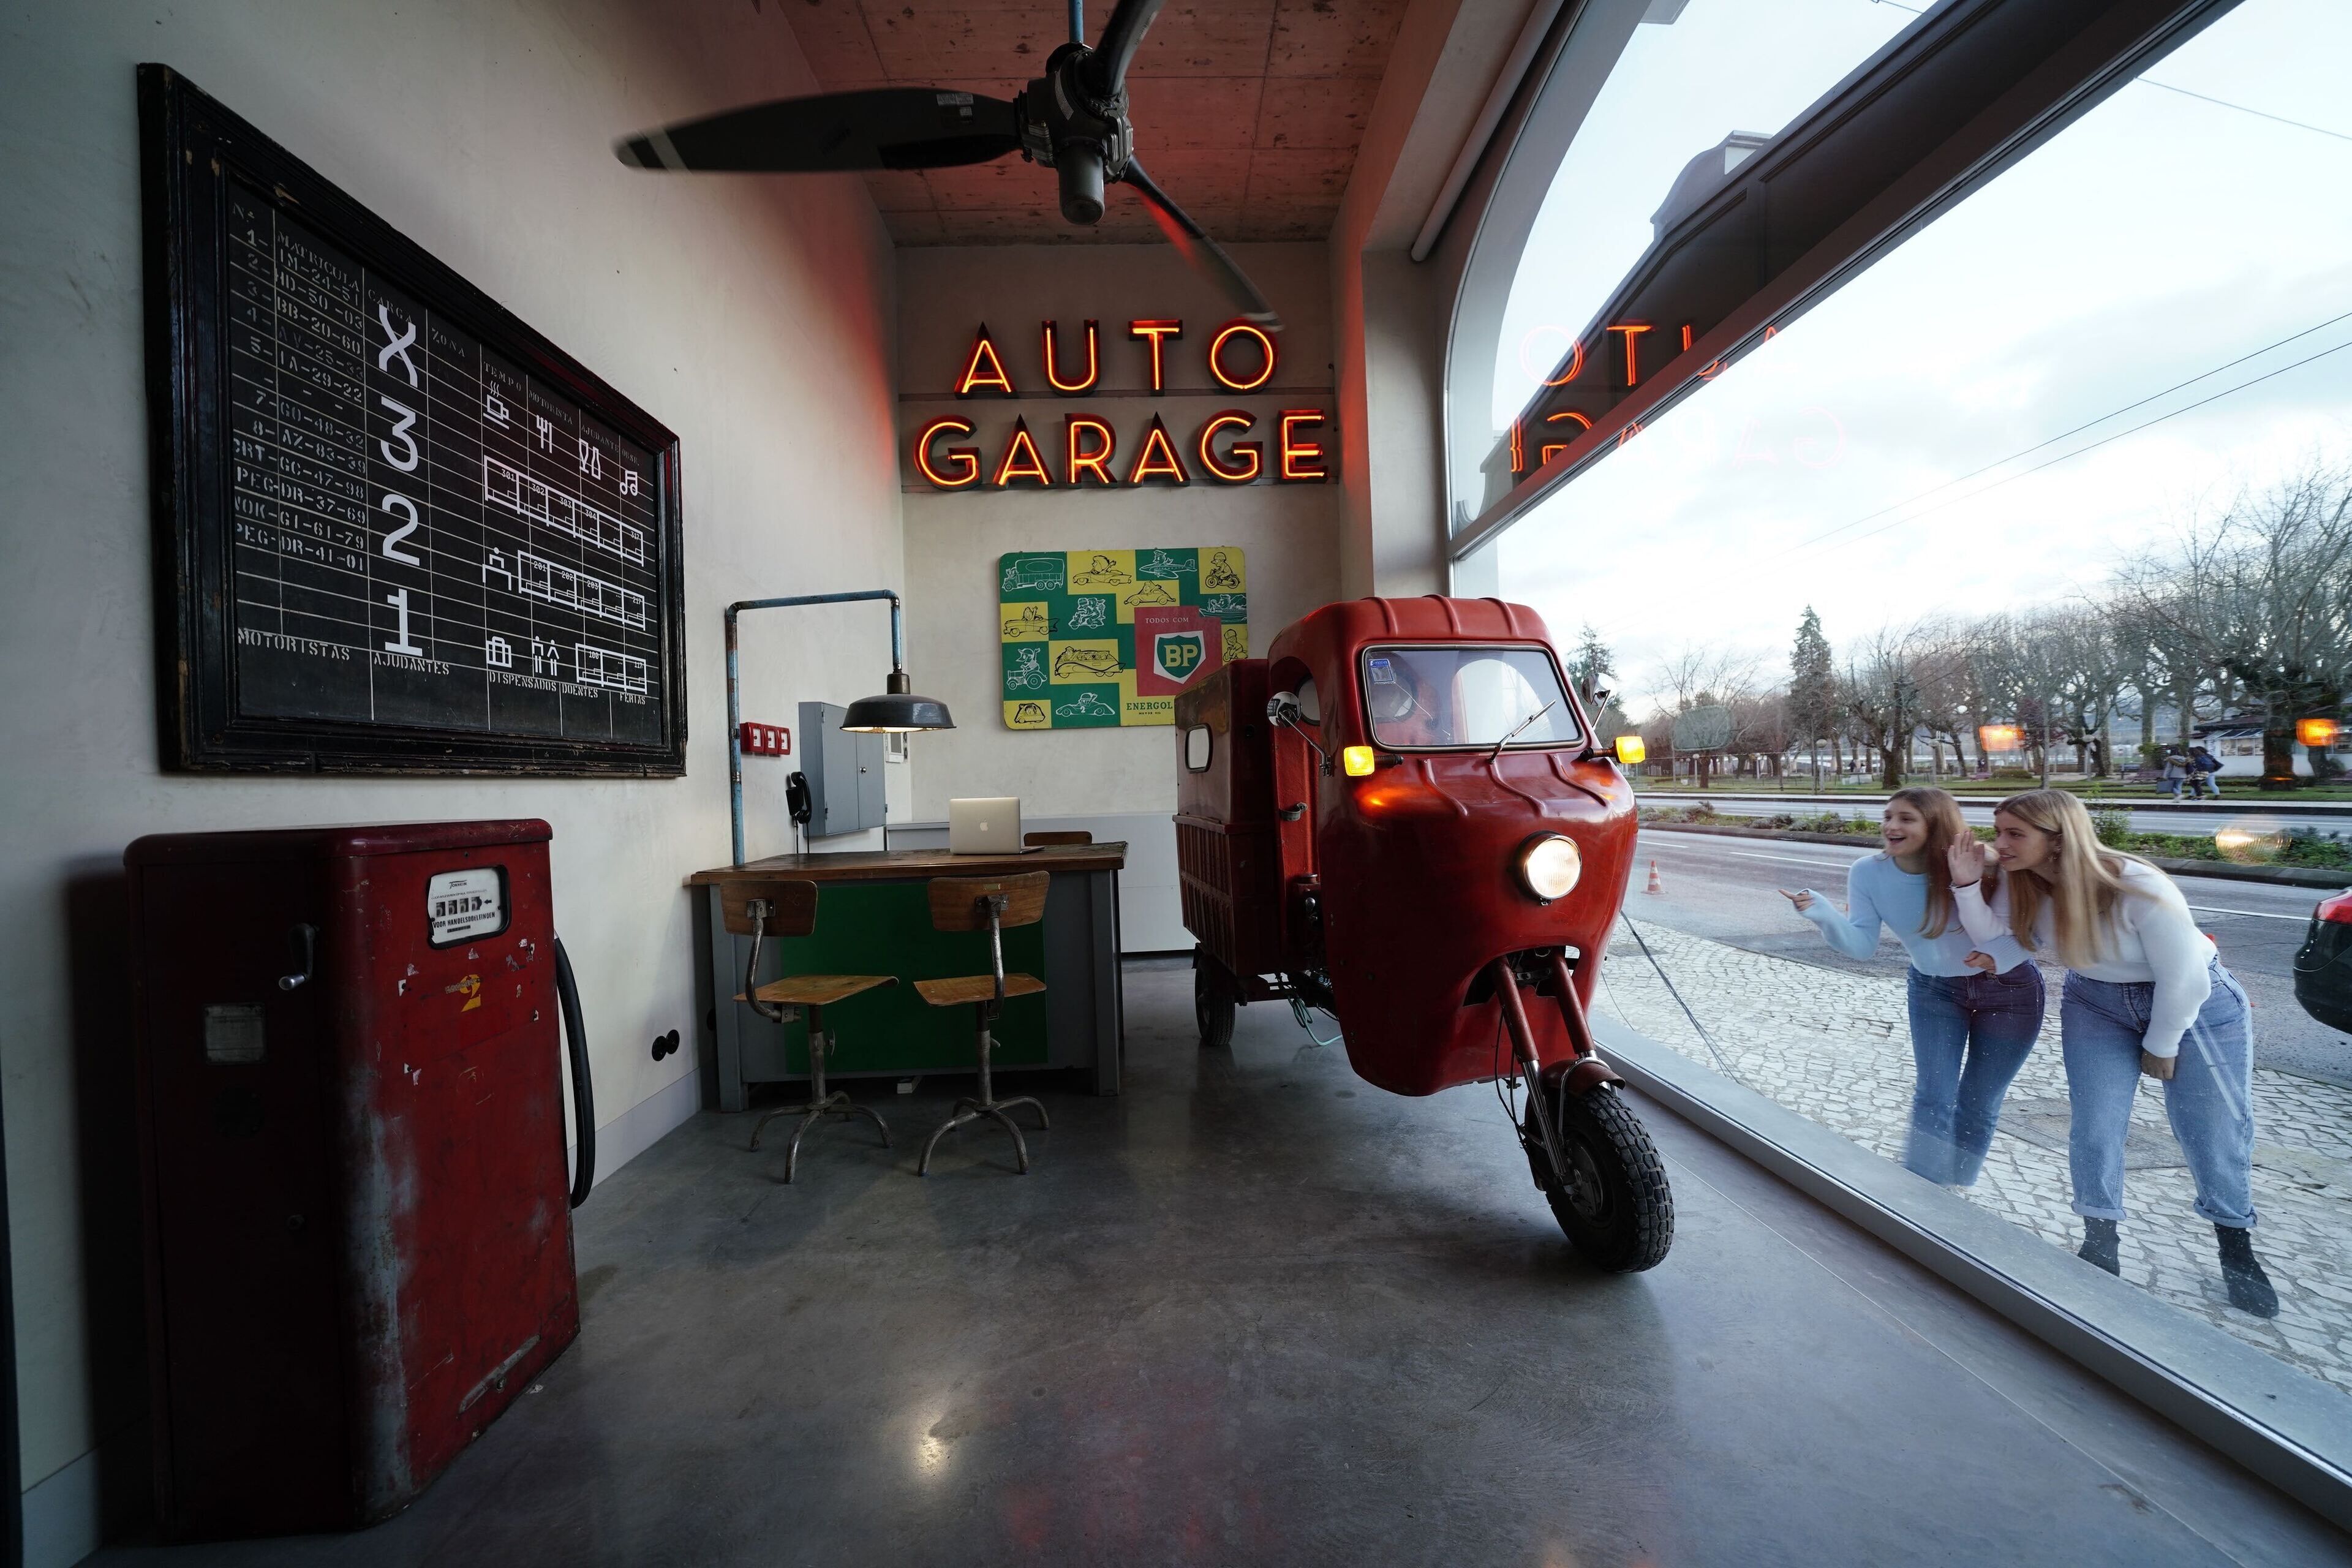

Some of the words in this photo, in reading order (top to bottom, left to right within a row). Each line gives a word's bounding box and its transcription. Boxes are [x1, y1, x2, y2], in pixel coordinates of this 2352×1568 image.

[277, 232, 360, 292] MATRICULA
[368, 289, 413, 323] CARGA
[379, 304, 418, 388] X
[431, 328, 466, 358] ZONA
[954, 318, 1280, 399] AUTO
[484, 361, 522, 392] TEMPO
[529, 390, 574, 425] MOTORISTA
[381, 396, 418, 472] 3
[581, 424, 620, 453] AJUDANTE
[913, 409, 1329, 489] GARAGE
[501, 468, 515, 482] 301
[531, 483, 545, 496] 302
[559, 497, 572, 509] 303
[585, 509, 597, 521] 304
[630, 530, 640, 540] 317
[382, 494, 420, 567] 2
[533, 560, 546, 572] 201
[561, 571, 574, 581] 202
[587, 579, 599, 590] 203
[632, 596, 642, 605] 217
[385, 588, 423, 657] 1
[238, 627, 350, 661] MOTORISTAS
[1164, 644, 1199, 668] BP
[374, 652, 450, 676] AJUDANTES
[489, 671, 557, 693] DISPENSADOS
[562, 684, 598, 698] DOENTES
[620, 692, 646, 705] FERIAS
[1126, 701, 1173, 710] ENERGOL
[432, 920, 447, 929] VOOR
[460, 974, 481, 1013] 2
